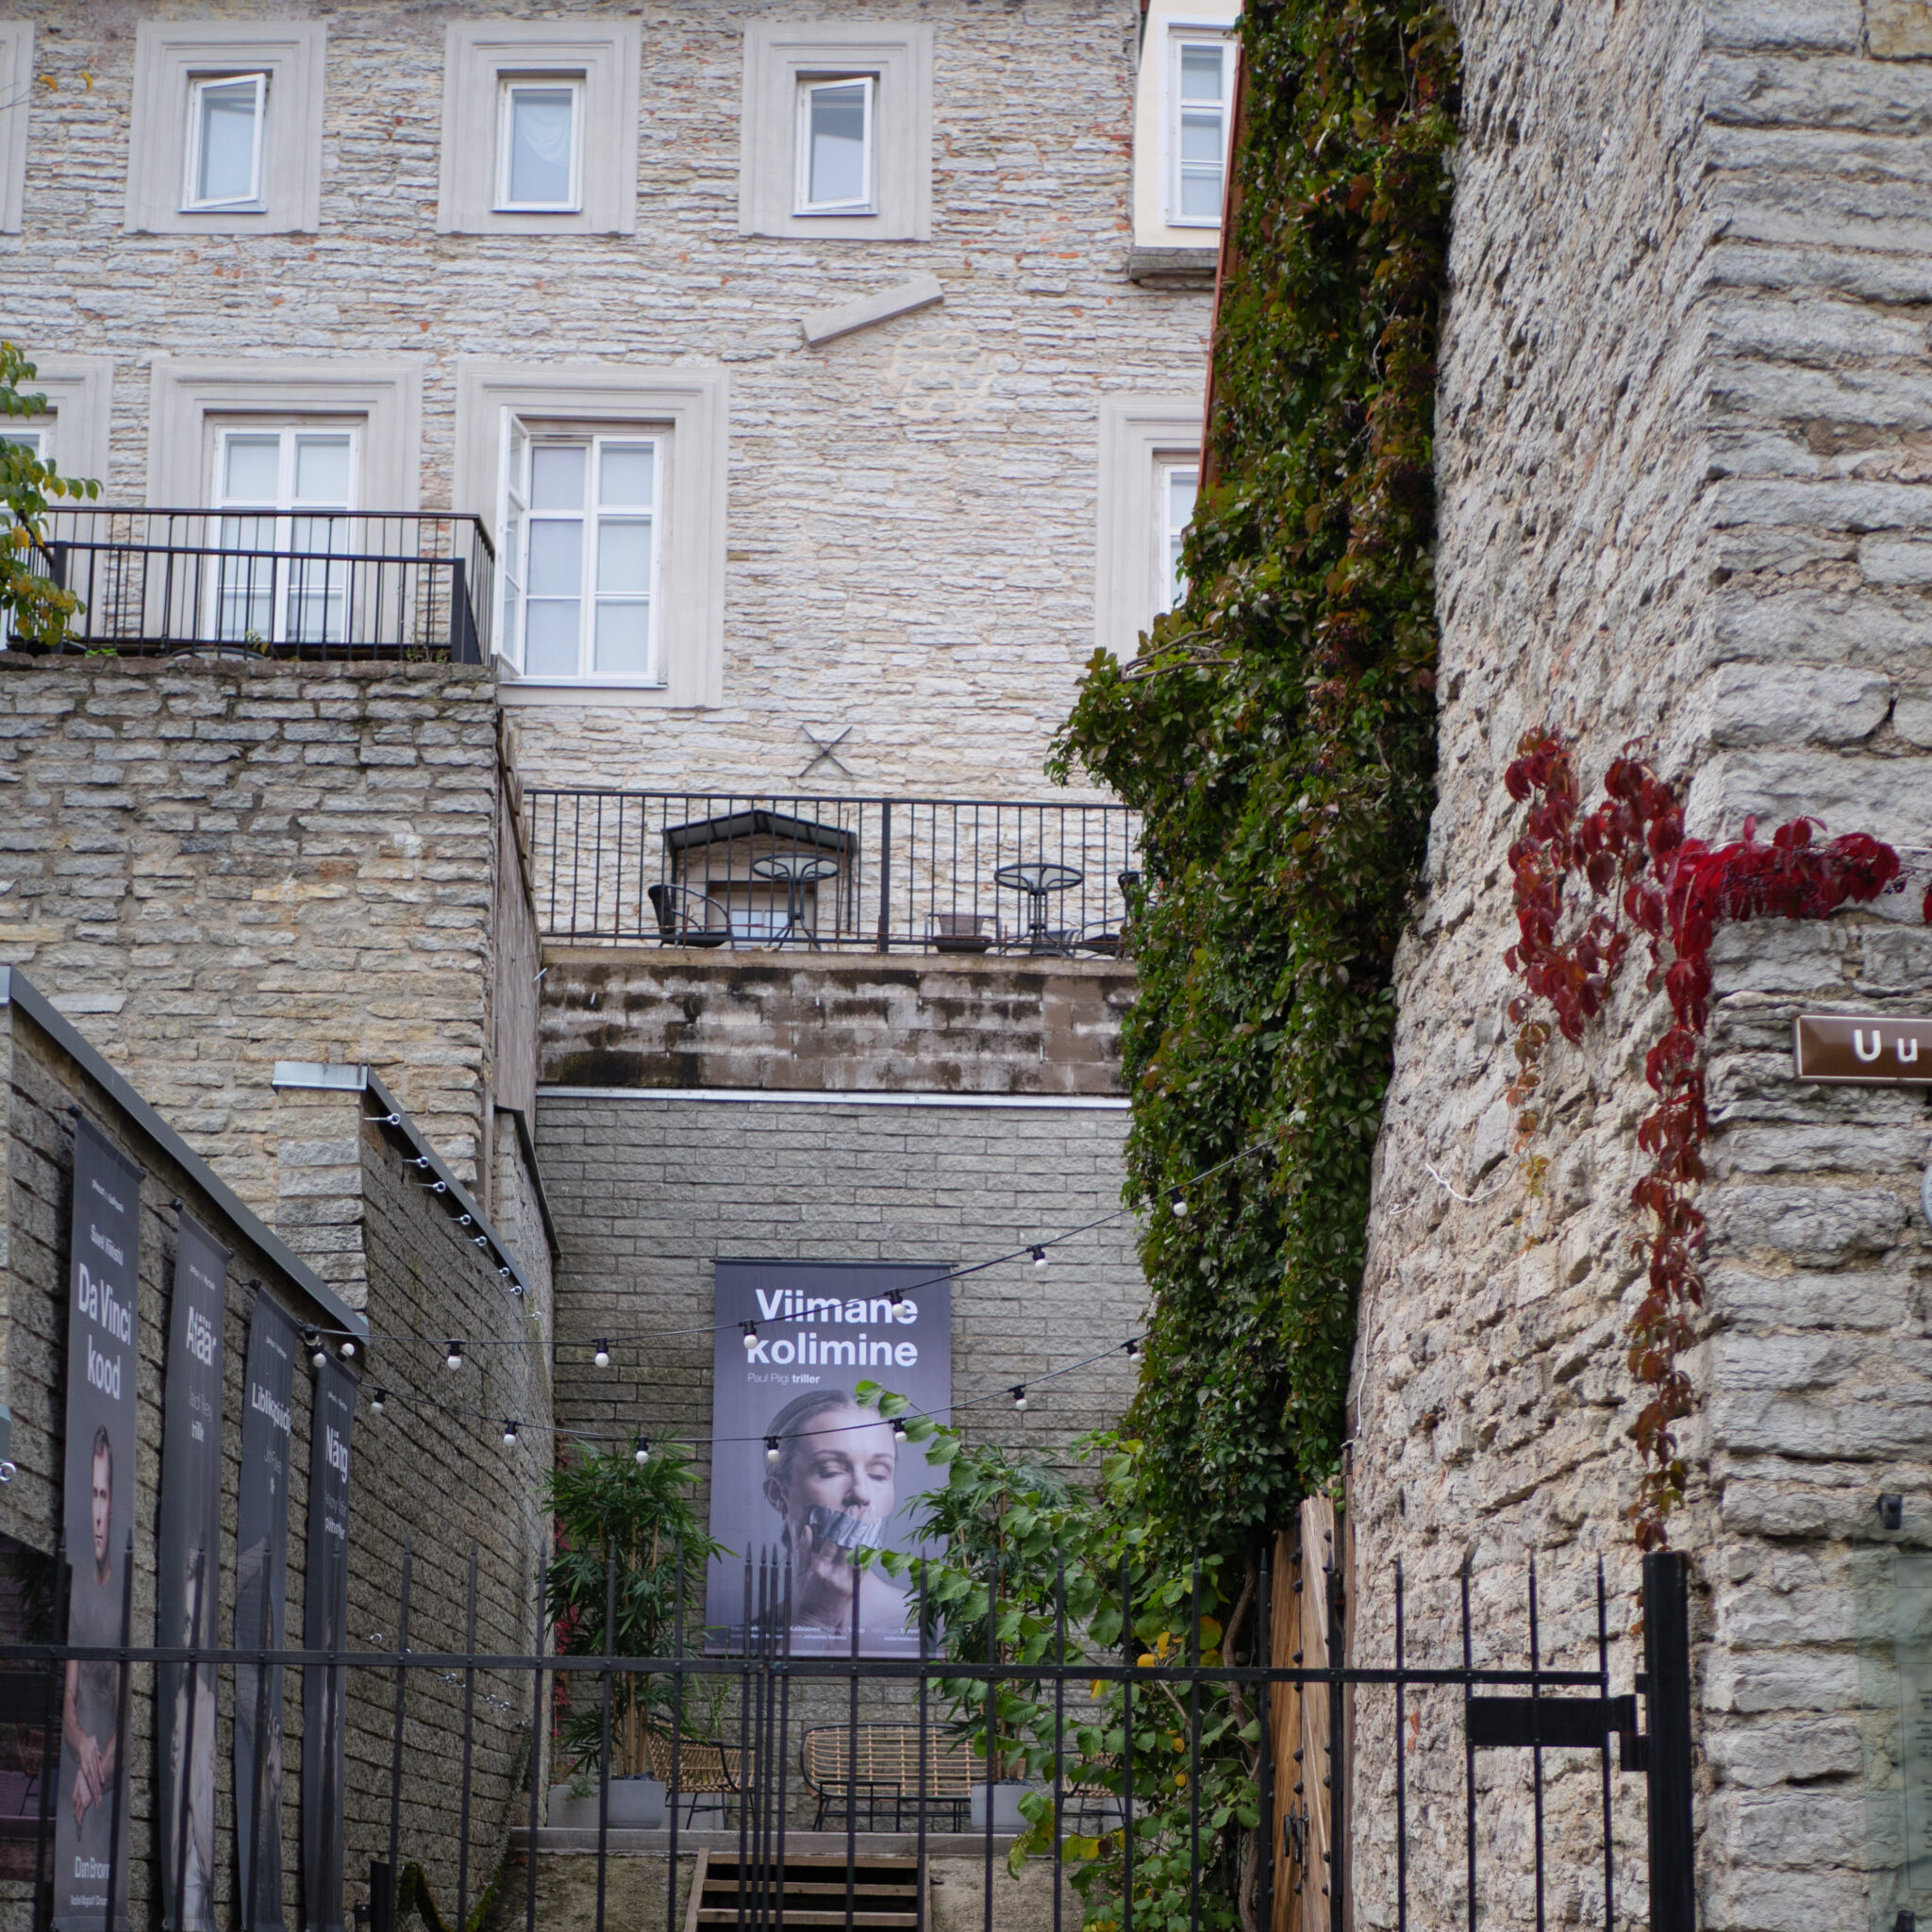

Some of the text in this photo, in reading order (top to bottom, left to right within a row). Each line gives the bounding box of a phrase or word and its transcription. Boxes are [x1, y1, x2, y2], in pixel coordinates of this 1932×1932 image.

[78, 1262, 131, 1345] Da Vinci
[756, 1289, 918, 1324] Viimane
[88, 1334, 121, 1400] kood
[746, 1332, 918, 1367] kolimine
[747, 1373, 768, 1383] Paul
[792, 1374, 821, 1384] triller
[75, 1856, 90, 1878] Dan
